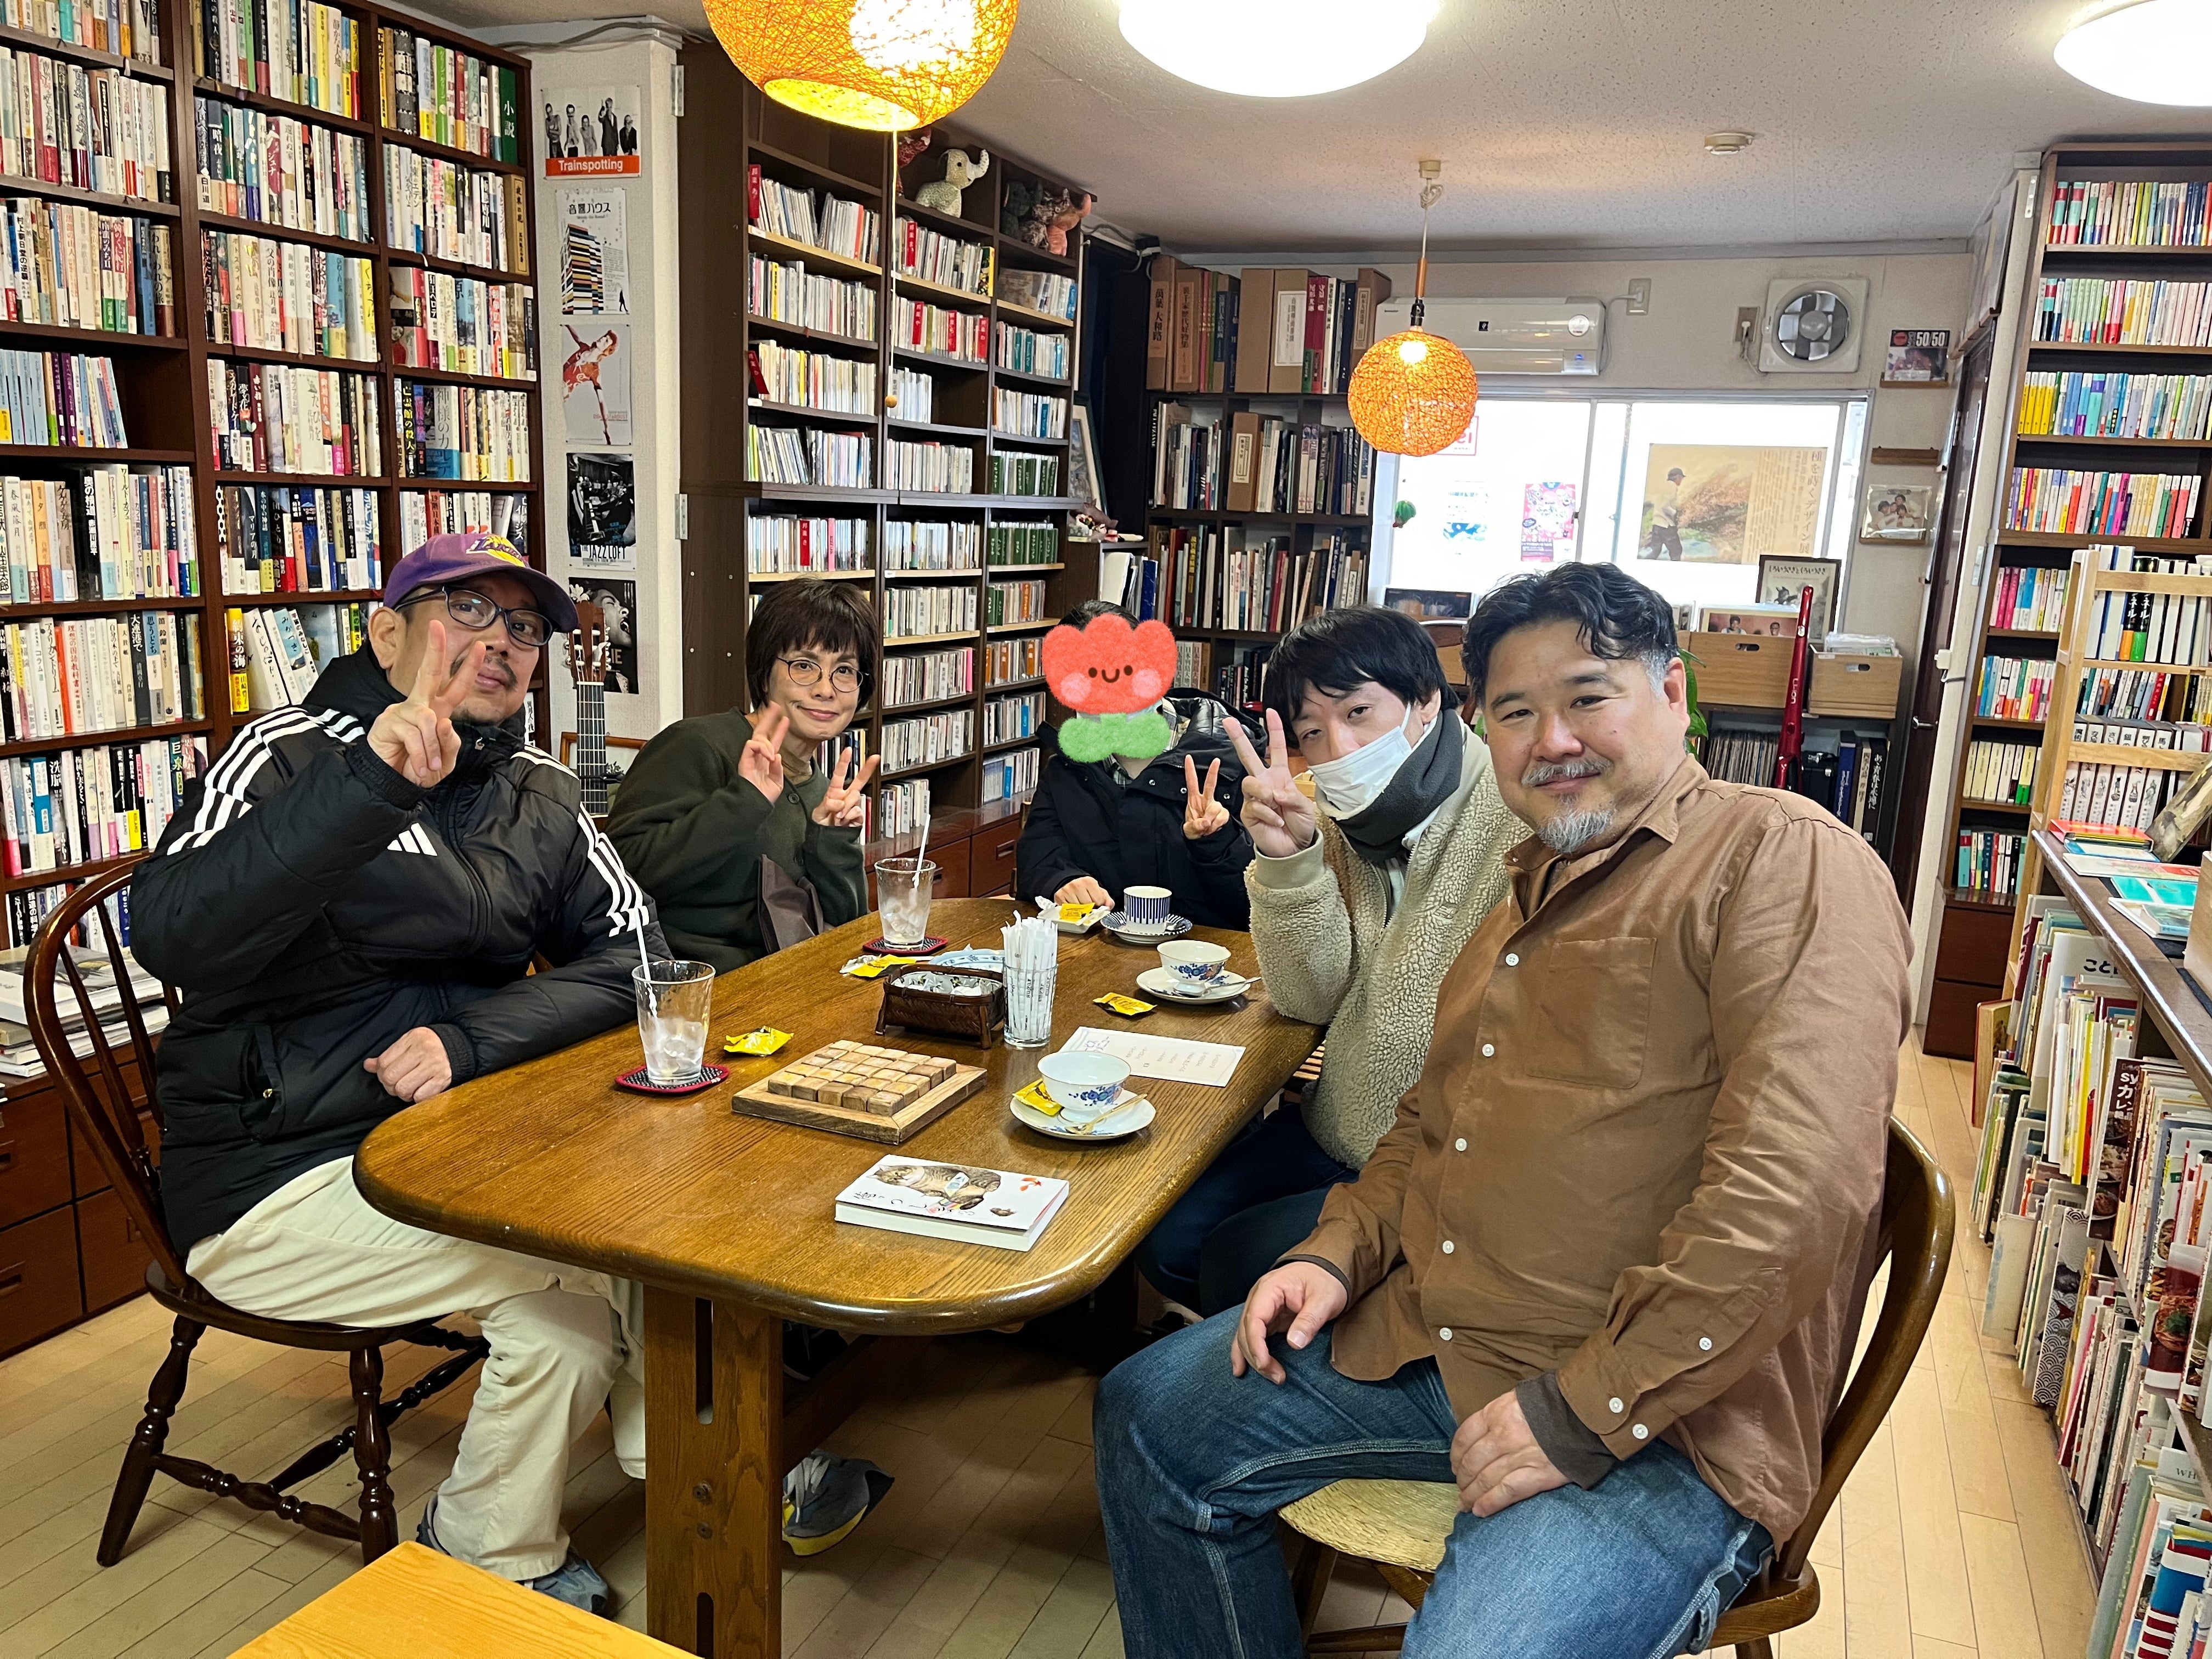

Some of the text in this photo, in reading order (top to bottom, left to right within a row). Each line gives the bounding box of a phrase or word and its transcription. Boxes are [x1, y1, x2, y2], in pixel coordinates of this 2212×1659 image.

[504, 100, 515, 138] 小説
[558, 158, 623, 172] Trainspotting
[248, 515, 257, 559] マリアの月
[172, 742, 183, 770] 巨泉
[49, 760, 61, 787] 洗脳
